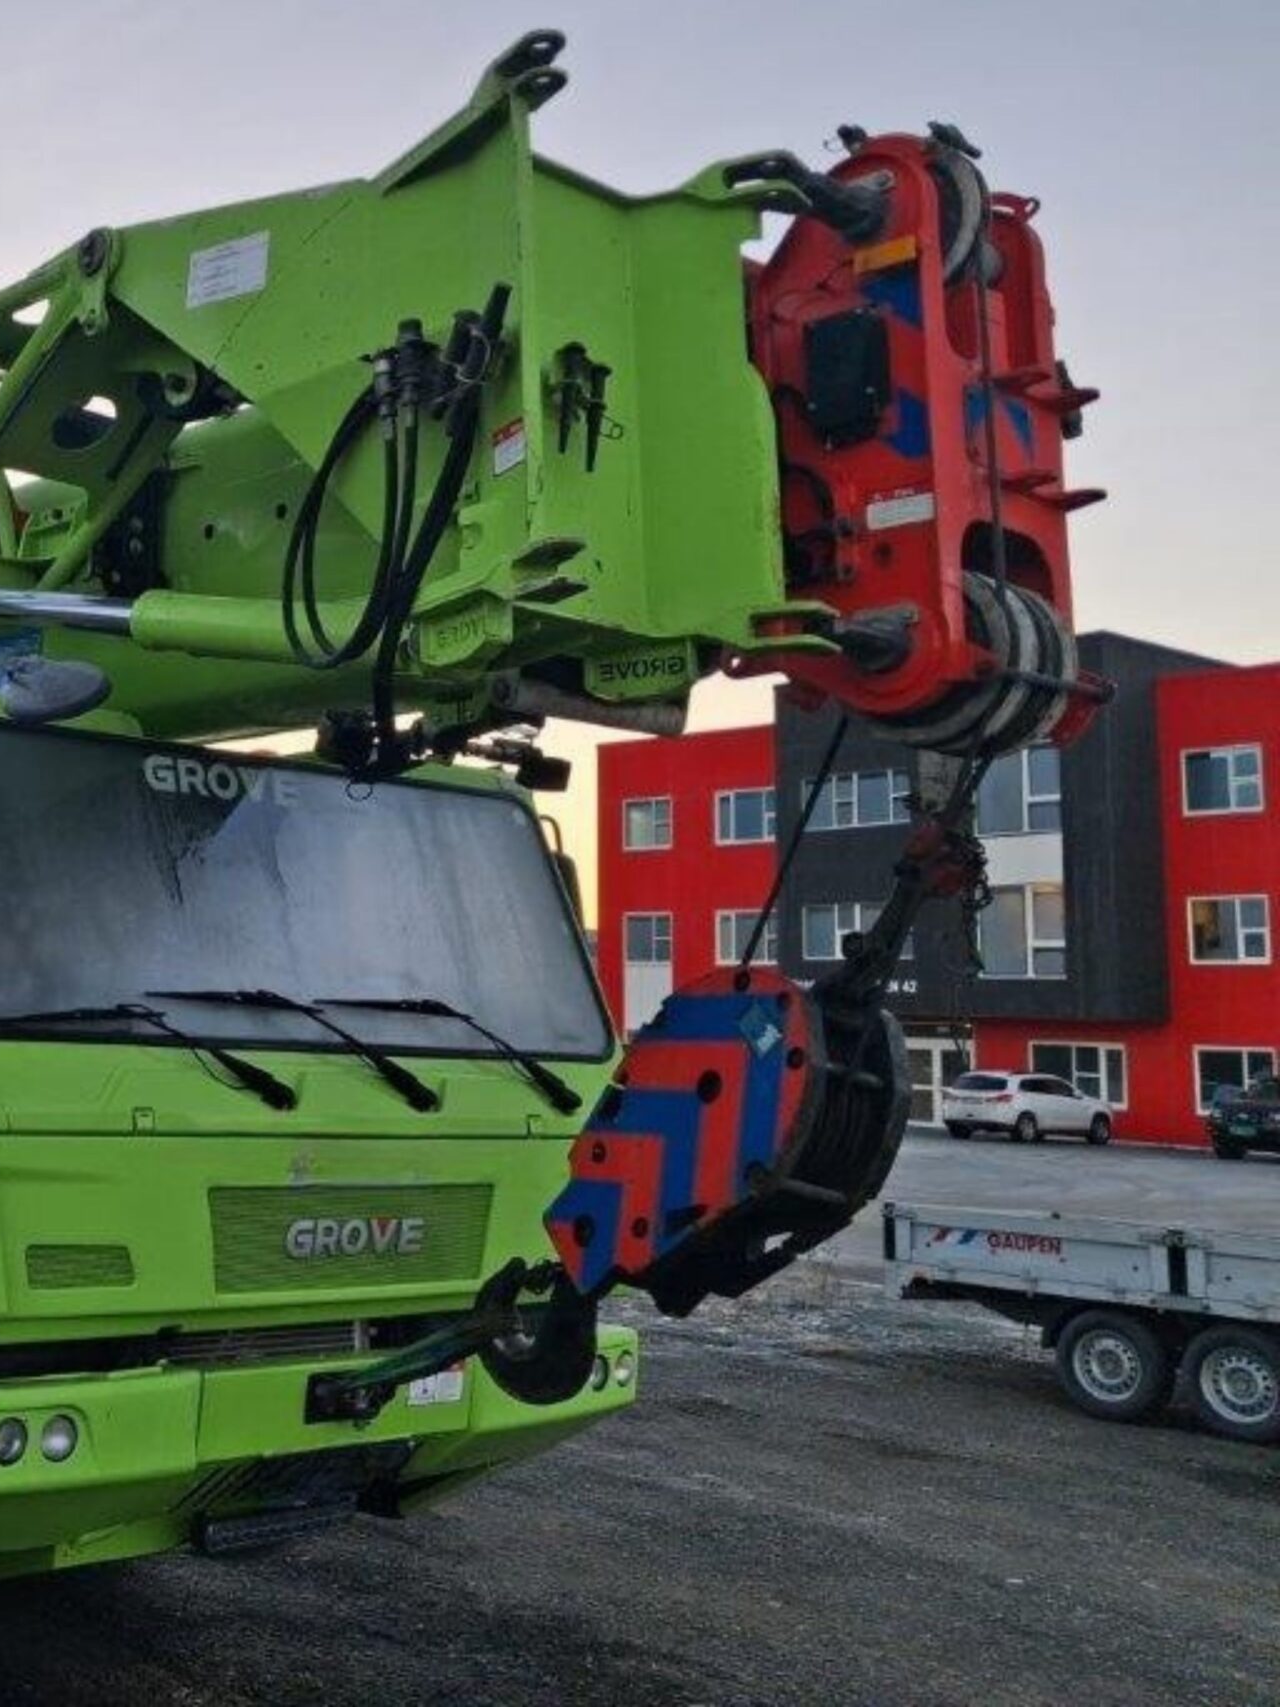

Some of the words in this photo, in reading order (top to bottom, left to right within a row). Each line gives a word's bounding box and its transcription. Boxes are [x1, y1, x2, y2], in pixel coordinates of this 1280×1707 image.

[144, 755, 300, 805] GROVE
[285, 1217, 424, 1259] GROVE
[987, 1232, 1061, 1255] GAUPEN
